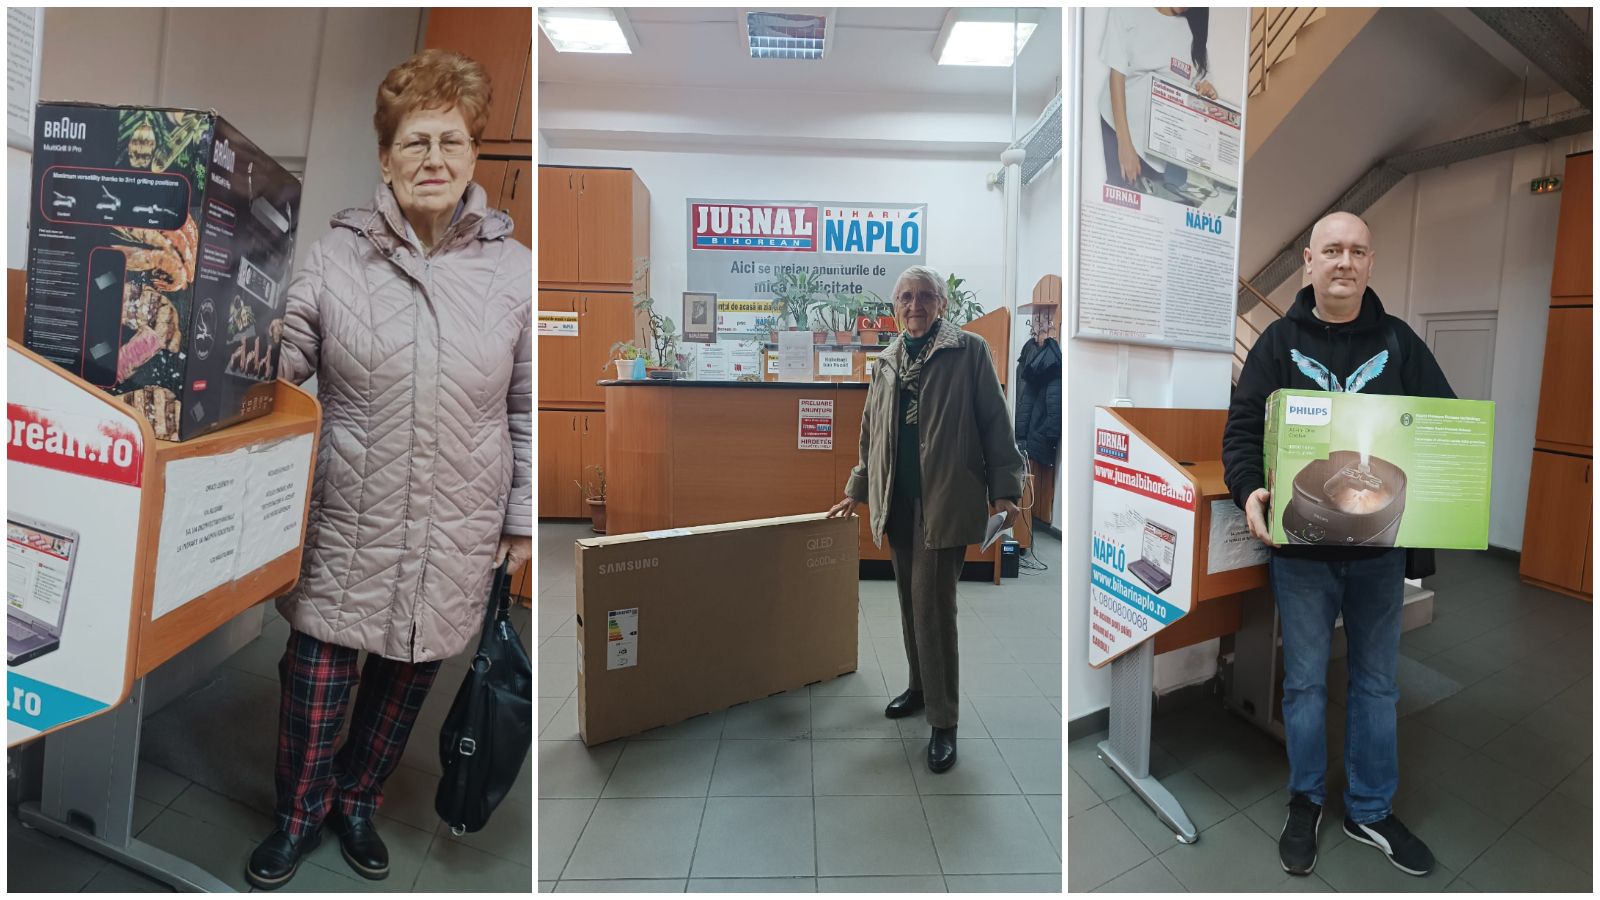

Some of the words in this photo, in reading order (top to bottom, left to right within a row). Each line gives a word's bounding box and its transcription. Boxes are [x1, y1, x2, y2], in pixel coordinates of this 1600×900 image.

[44, 116, 86, 140] BRAUN
[72, 145, 82, 153] Pro
[212, 139, 235, 173] BRAUN
[78, 174, 100, 182] versatility
[1105, 187, 1139, 205] JURNAL
[697, 206, 812, 235] JURNAL
[825, 210, 900, 218] BIHARI
[825, 212, 919, 254] NAPLÓ
[1186, 213, 1222, 235] NAPLÓ
[712, 237, 800, 246] BIHOREAN
[730, 261, 755, 274] Aici
[758, 265, 770, 274] se
[872, 265, 886, 276] de
[1290, 406, 1328, 416] PHILIPS
[1098, 431, 1127, 451] JURNAL
[807, 537, 833, 550] QLED
[1094, 536, 1125, 573] NAPLÓ
[599, 558, 659, 575] SAMSUNG
[1093, 569, 1166, 618] www.biharinaplo.ro
[1099, 592, 1147, 632] 0800800068
